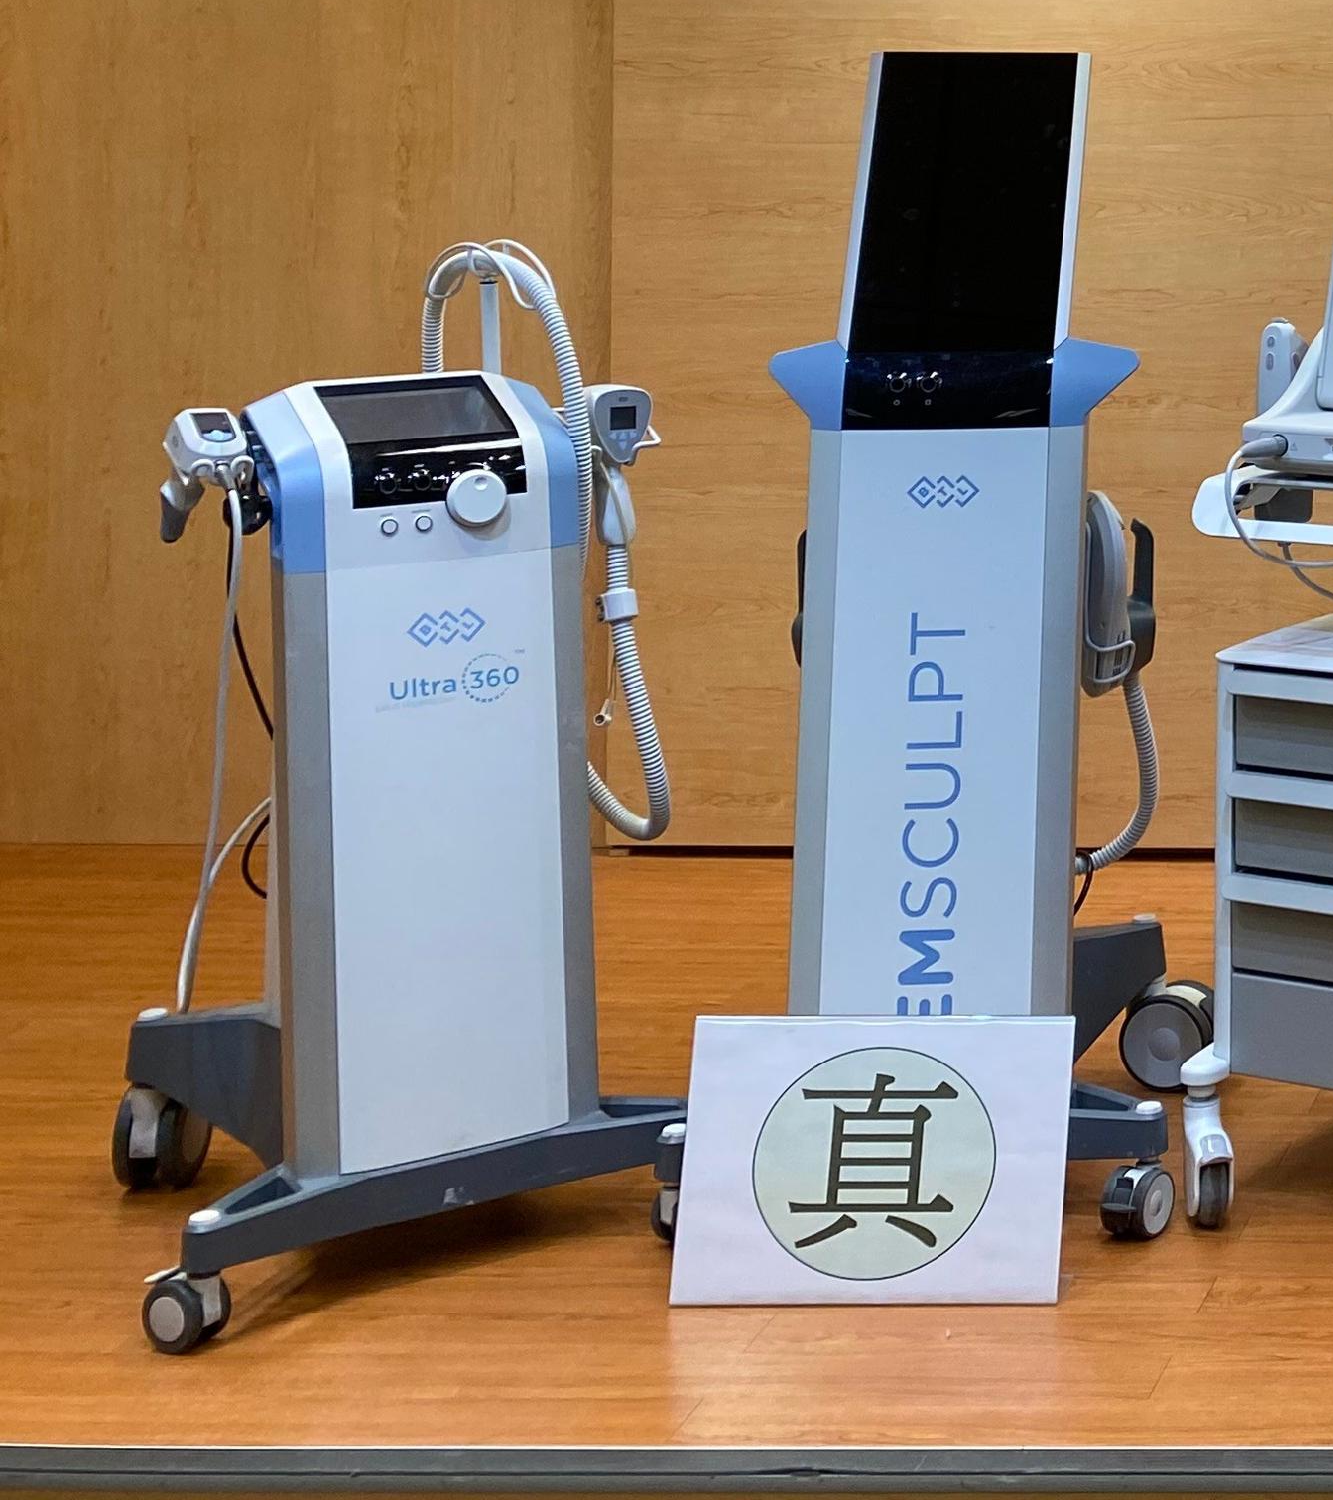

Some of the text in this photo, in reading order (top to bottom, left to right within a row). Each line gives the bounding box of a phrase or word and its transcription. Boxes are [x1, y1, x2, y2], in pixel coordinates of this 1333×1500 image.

[389, 665, 520, 700] Ultra 360
[788, 1073, 959, 1249] 真
